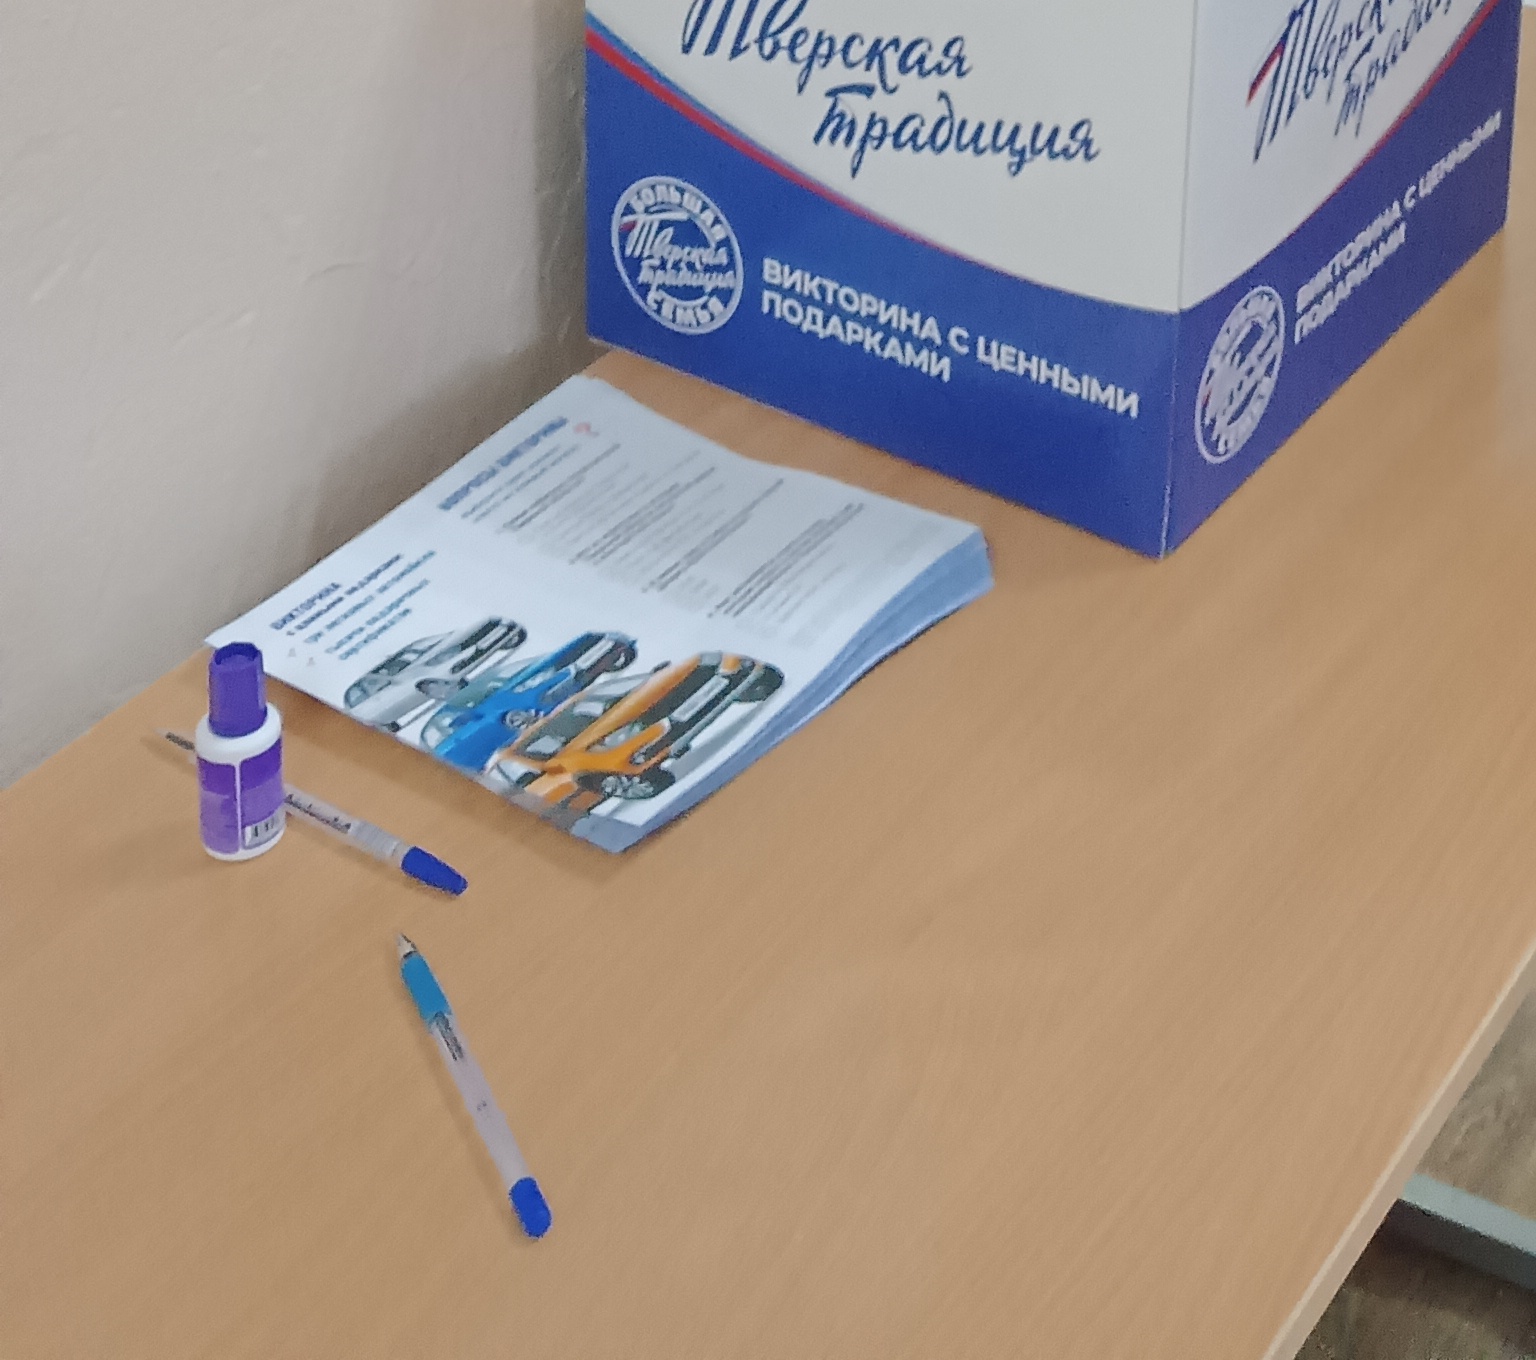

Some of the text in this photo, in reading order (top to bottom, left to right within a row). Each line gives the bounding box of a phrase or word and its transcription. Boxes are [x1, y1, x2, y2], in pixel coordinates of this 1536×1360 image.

[812, 82, 1101, 178] традиция
[1403, 184, 1417, 211] С
[761, 288, 952, 383] ПОДАРКАМИ
[762, 256, 943, 345] ВИКТОРИНА
[948, 324, 970, 356] С
[977, 336, 1140, 419] ЦЕННЫМИ
